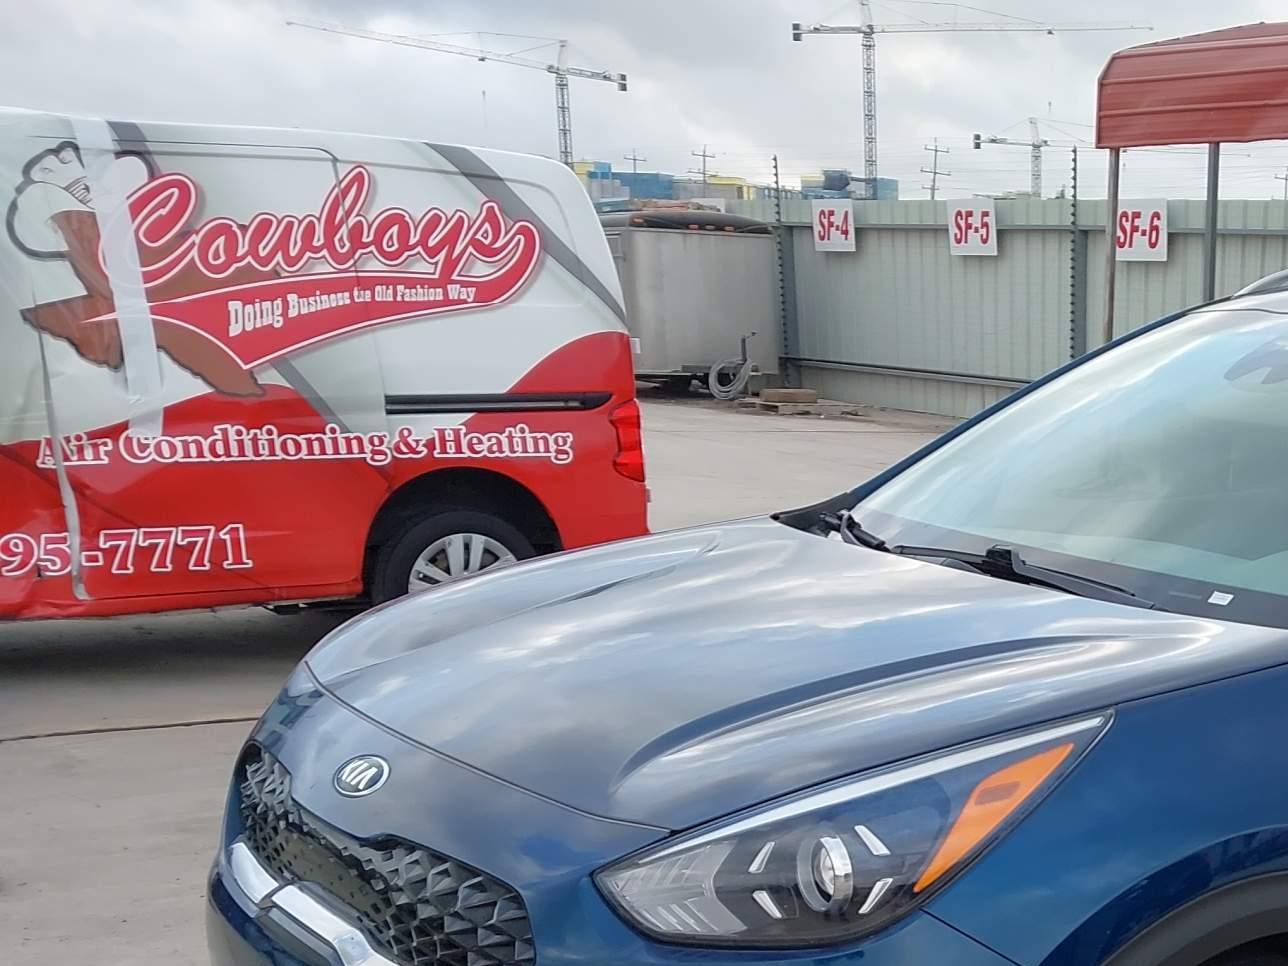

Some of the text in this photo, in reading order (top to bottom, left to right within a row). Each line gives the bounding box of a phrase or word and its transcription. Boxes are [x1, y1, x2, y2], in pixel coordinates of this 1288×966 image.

[98, 164, 540, 288] Cowboys
[818, 209, 849, 241] SF-4
[954, 211, 990, 245] SF-5
[1116, 210, 1161, 249] SF-6
[228, 284, 476, 337] Doing Business the Old Fashion Way
[36, 424, 573, 469] Air Conditioning & Heating
[0, 523, 254, 576] 95-7771
[341, 759, 379, 790] KIA
